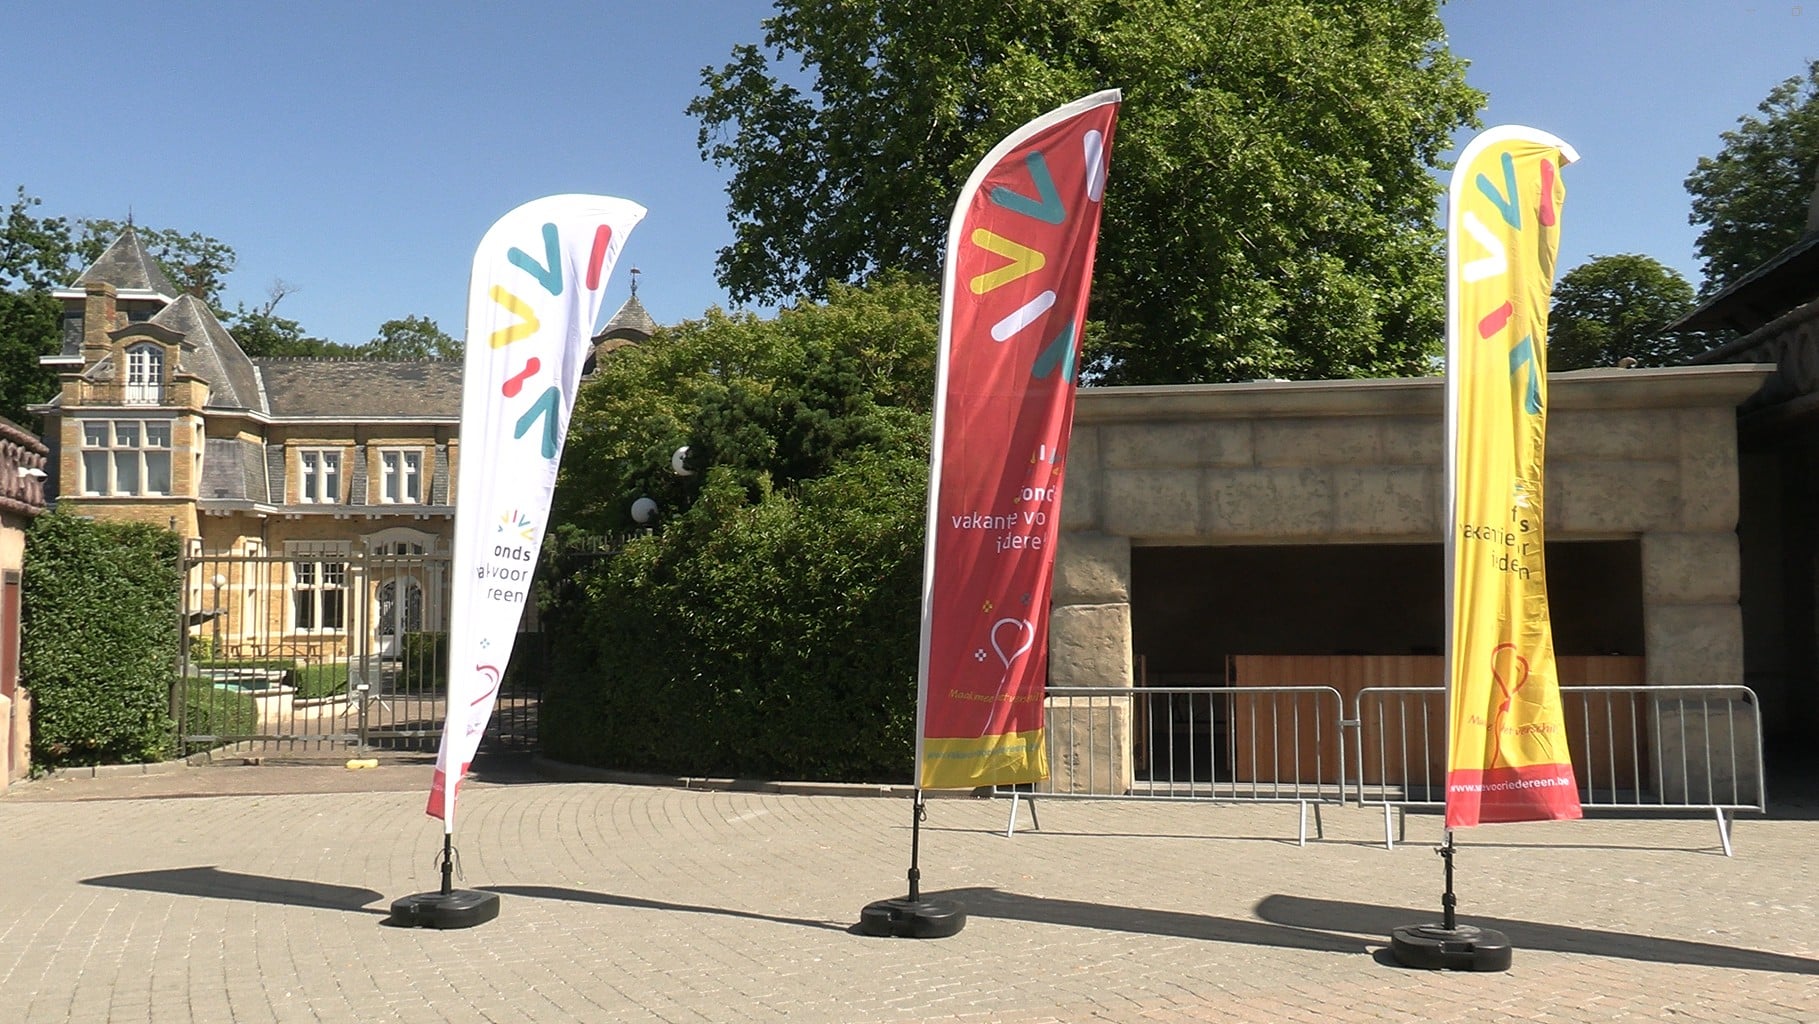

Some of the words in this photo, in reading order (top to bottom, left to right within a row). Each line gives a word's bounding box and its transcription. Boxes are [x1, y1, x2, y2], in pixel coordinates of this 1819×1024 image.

[1024, 511, 1046, 525] vo
[494, 545, 531, 561] onds
[487, 587, 524, 603] reen
